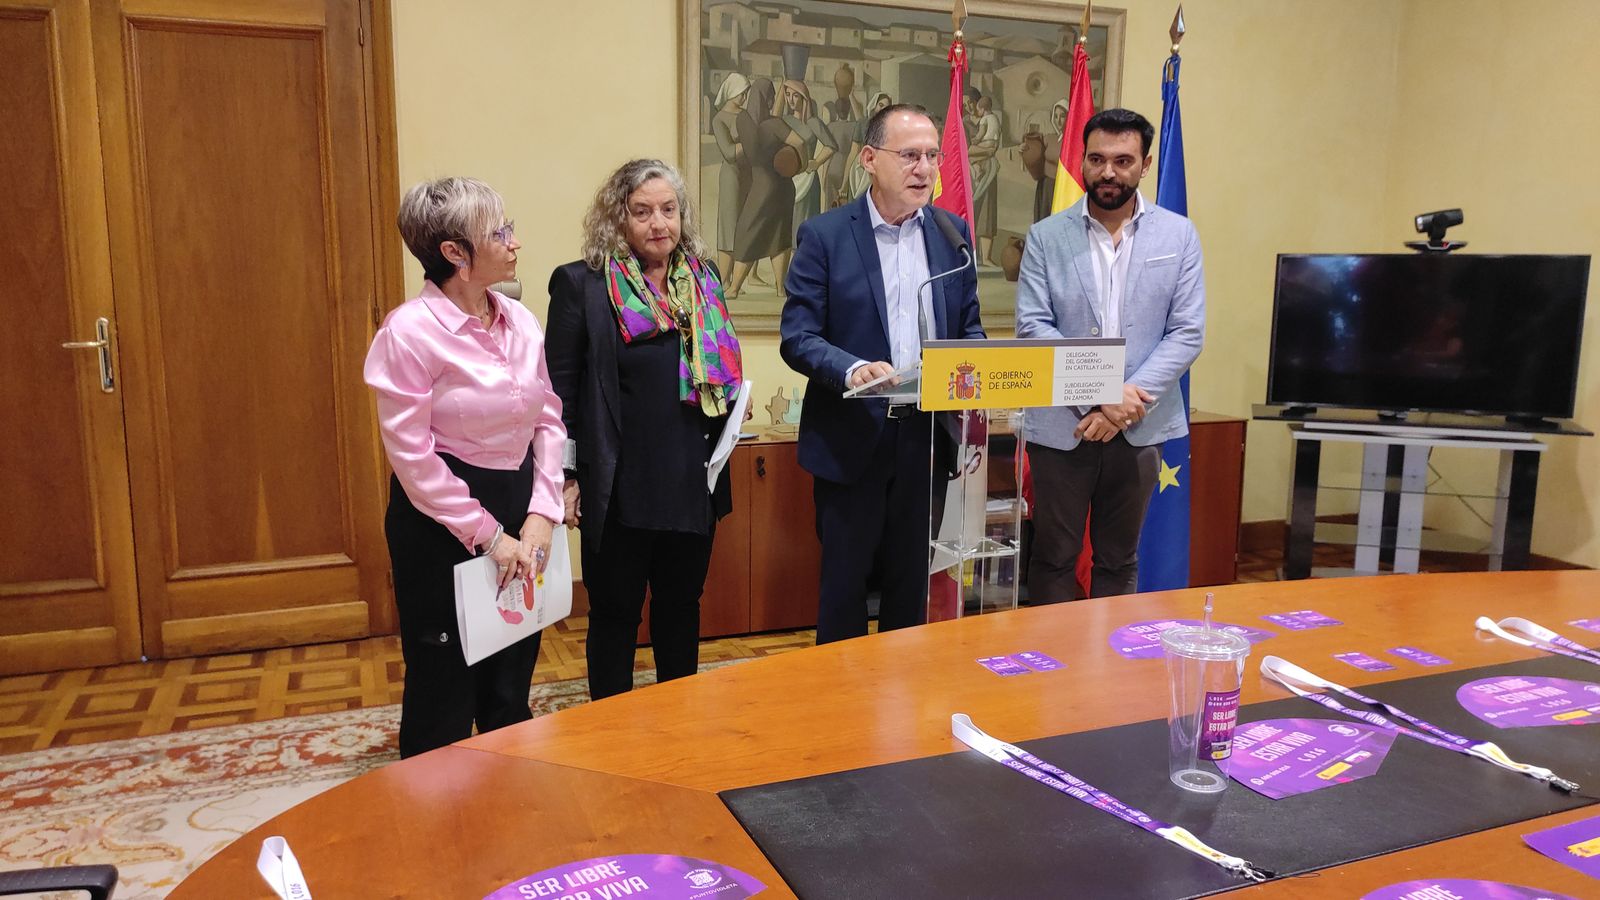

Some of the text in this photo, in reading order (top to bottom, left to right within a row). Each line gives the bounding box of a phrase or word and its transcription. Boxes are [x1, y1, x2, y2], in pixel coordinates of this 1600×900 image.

[989, 370, 1034, 380] GOBIERNO
[988, 379, 1033, 390] DE ESPAÑA
[1213, 711, 1225, 720] SER
[1365, 712, 1388, 726] VIVA
[1209, 722, 1227, 731] ESTAR
[1278, 731, 1317, 747] VIVA
[1065, 784, 1089, 799] VIVA
[518, 860, 627, 900] SER LIBRE
[593, 875, 650, 900] VIVA
